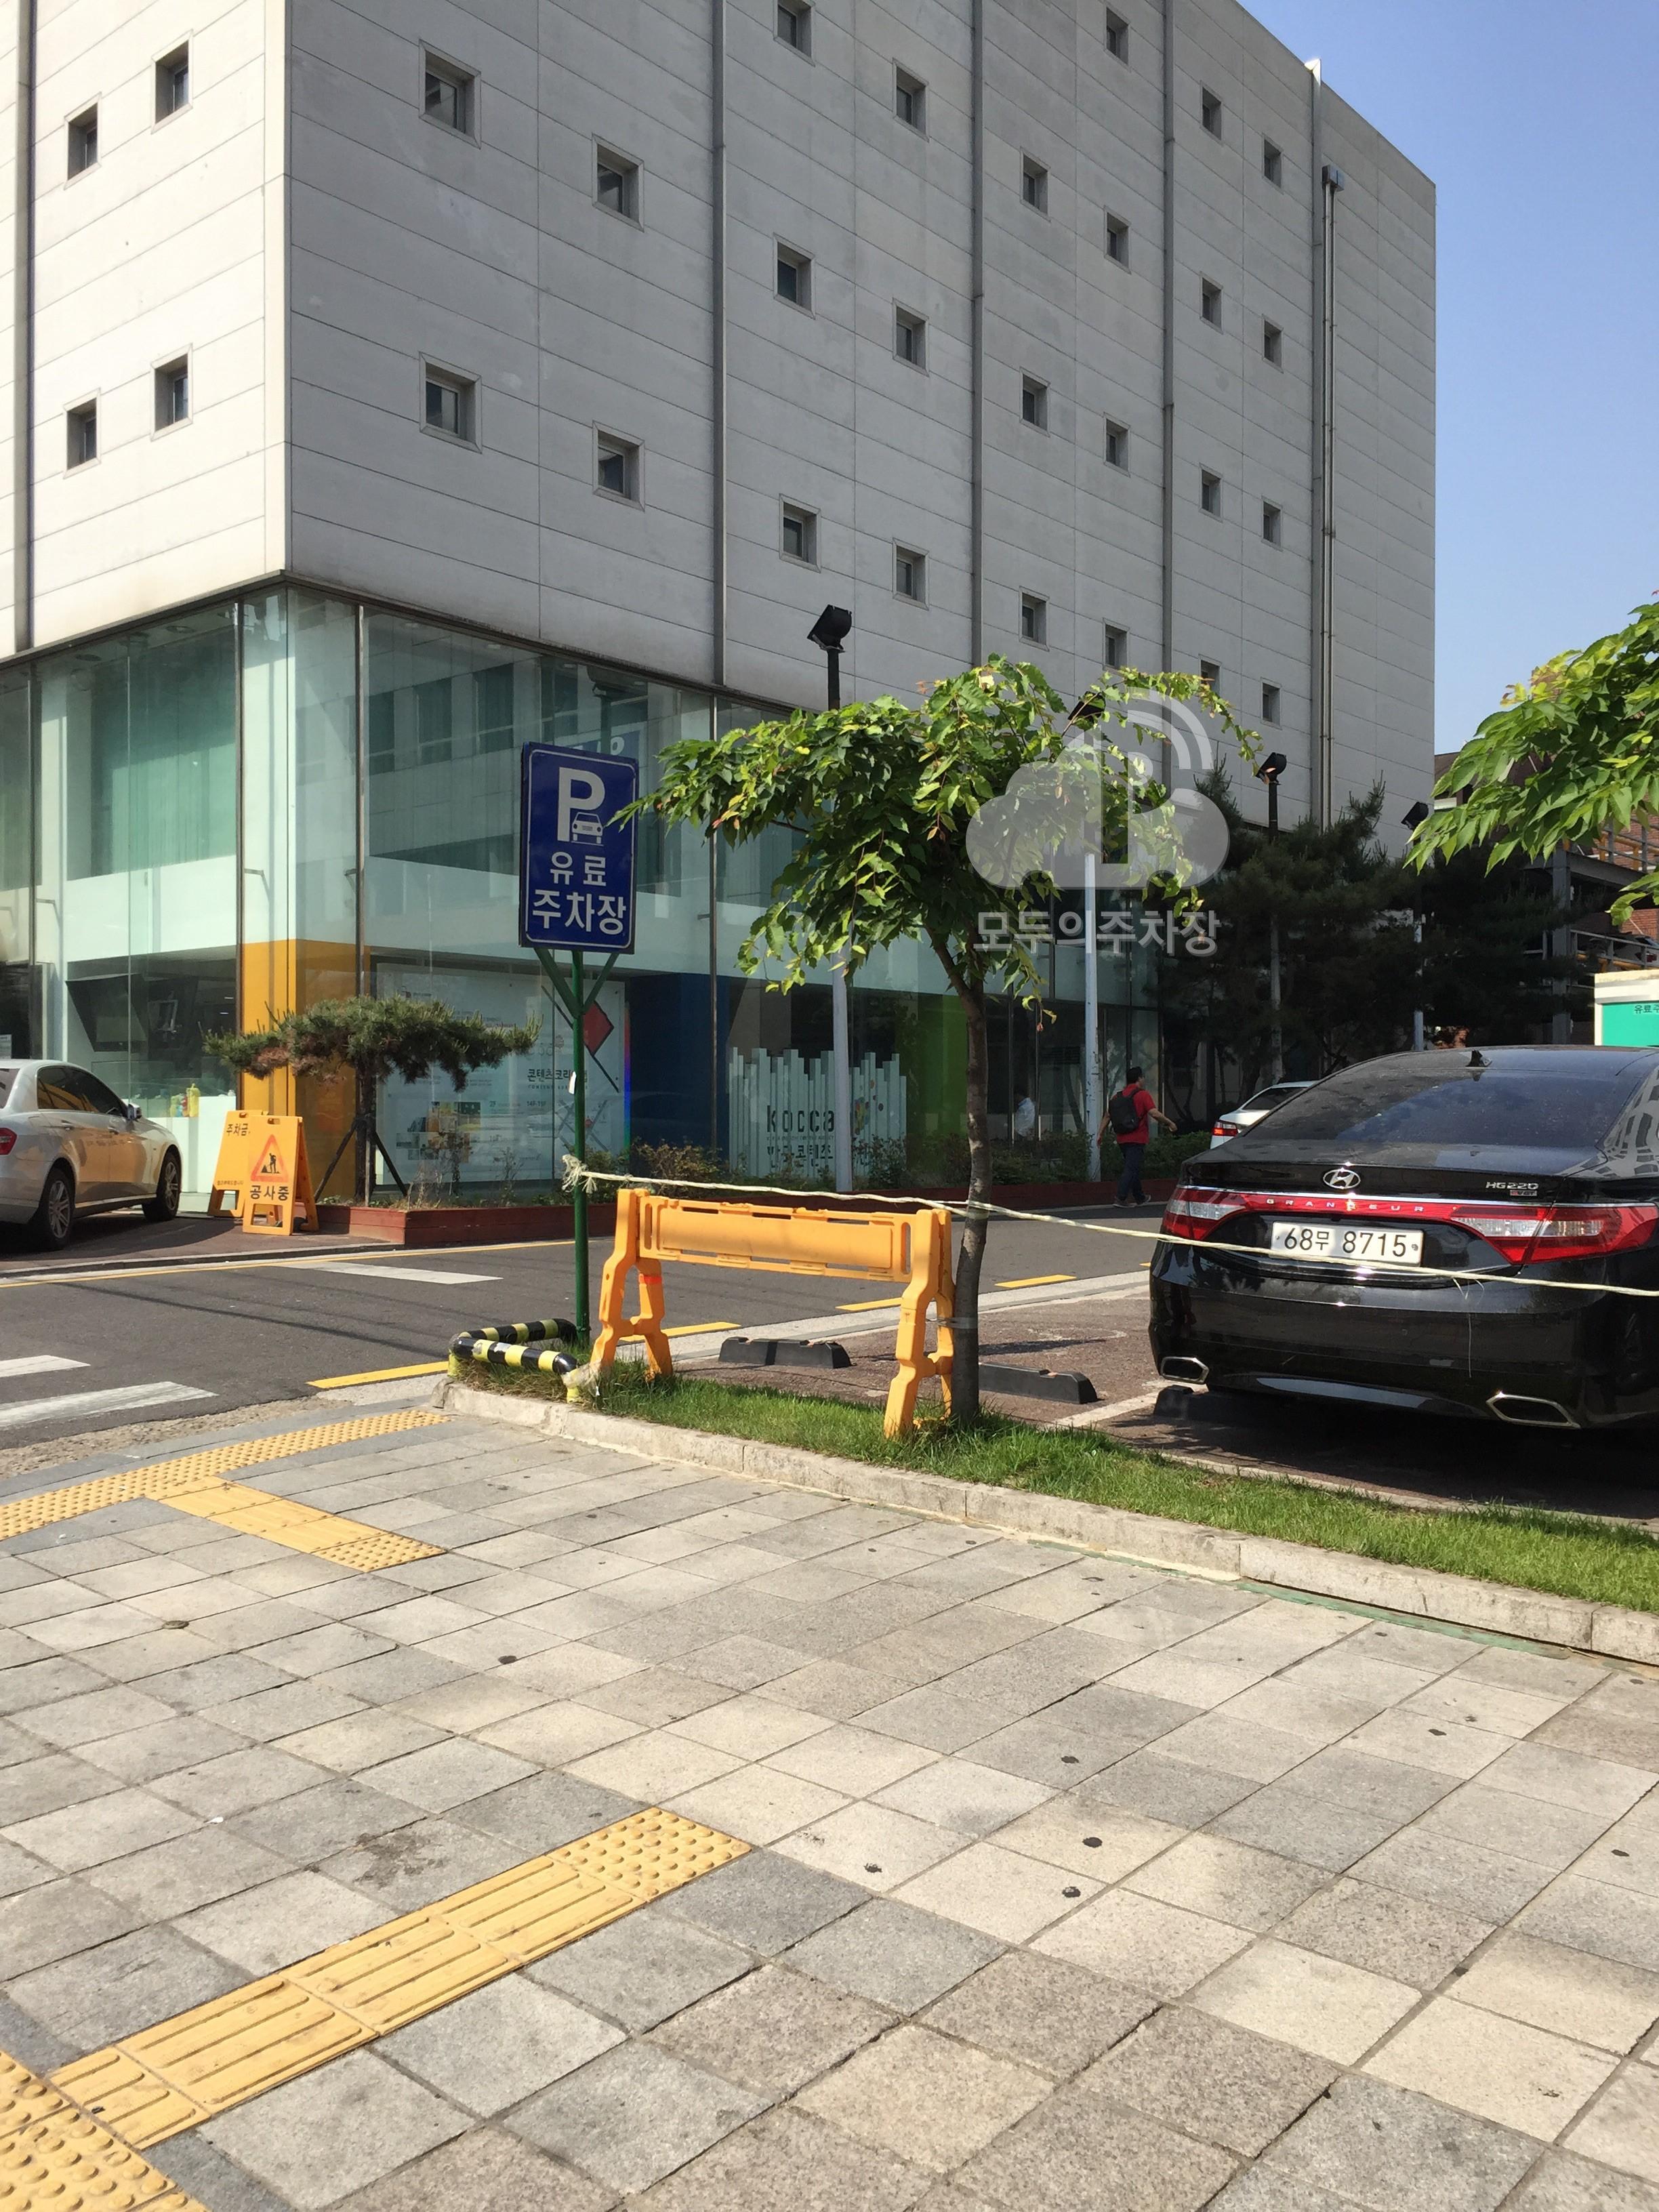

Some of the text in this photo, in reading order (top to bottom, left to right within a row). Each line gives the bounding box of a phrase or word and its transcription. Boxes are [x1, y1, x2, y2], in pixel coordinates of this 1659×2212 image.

[557, 766, 605, 842] P
[550, 851, 607, 886] 유료
[532, 889, 626, 935] 주차장
[527, 1069, 588, 1082] 콘텐츠코리
[226, 1123, 251, 1136] 주차금
[249, 1185, 289, 1201] 공사중
[1266, 1198, 1425, 1213] GRANDEUR
[1284, 1227, 1407, 1258] 68무 8715
